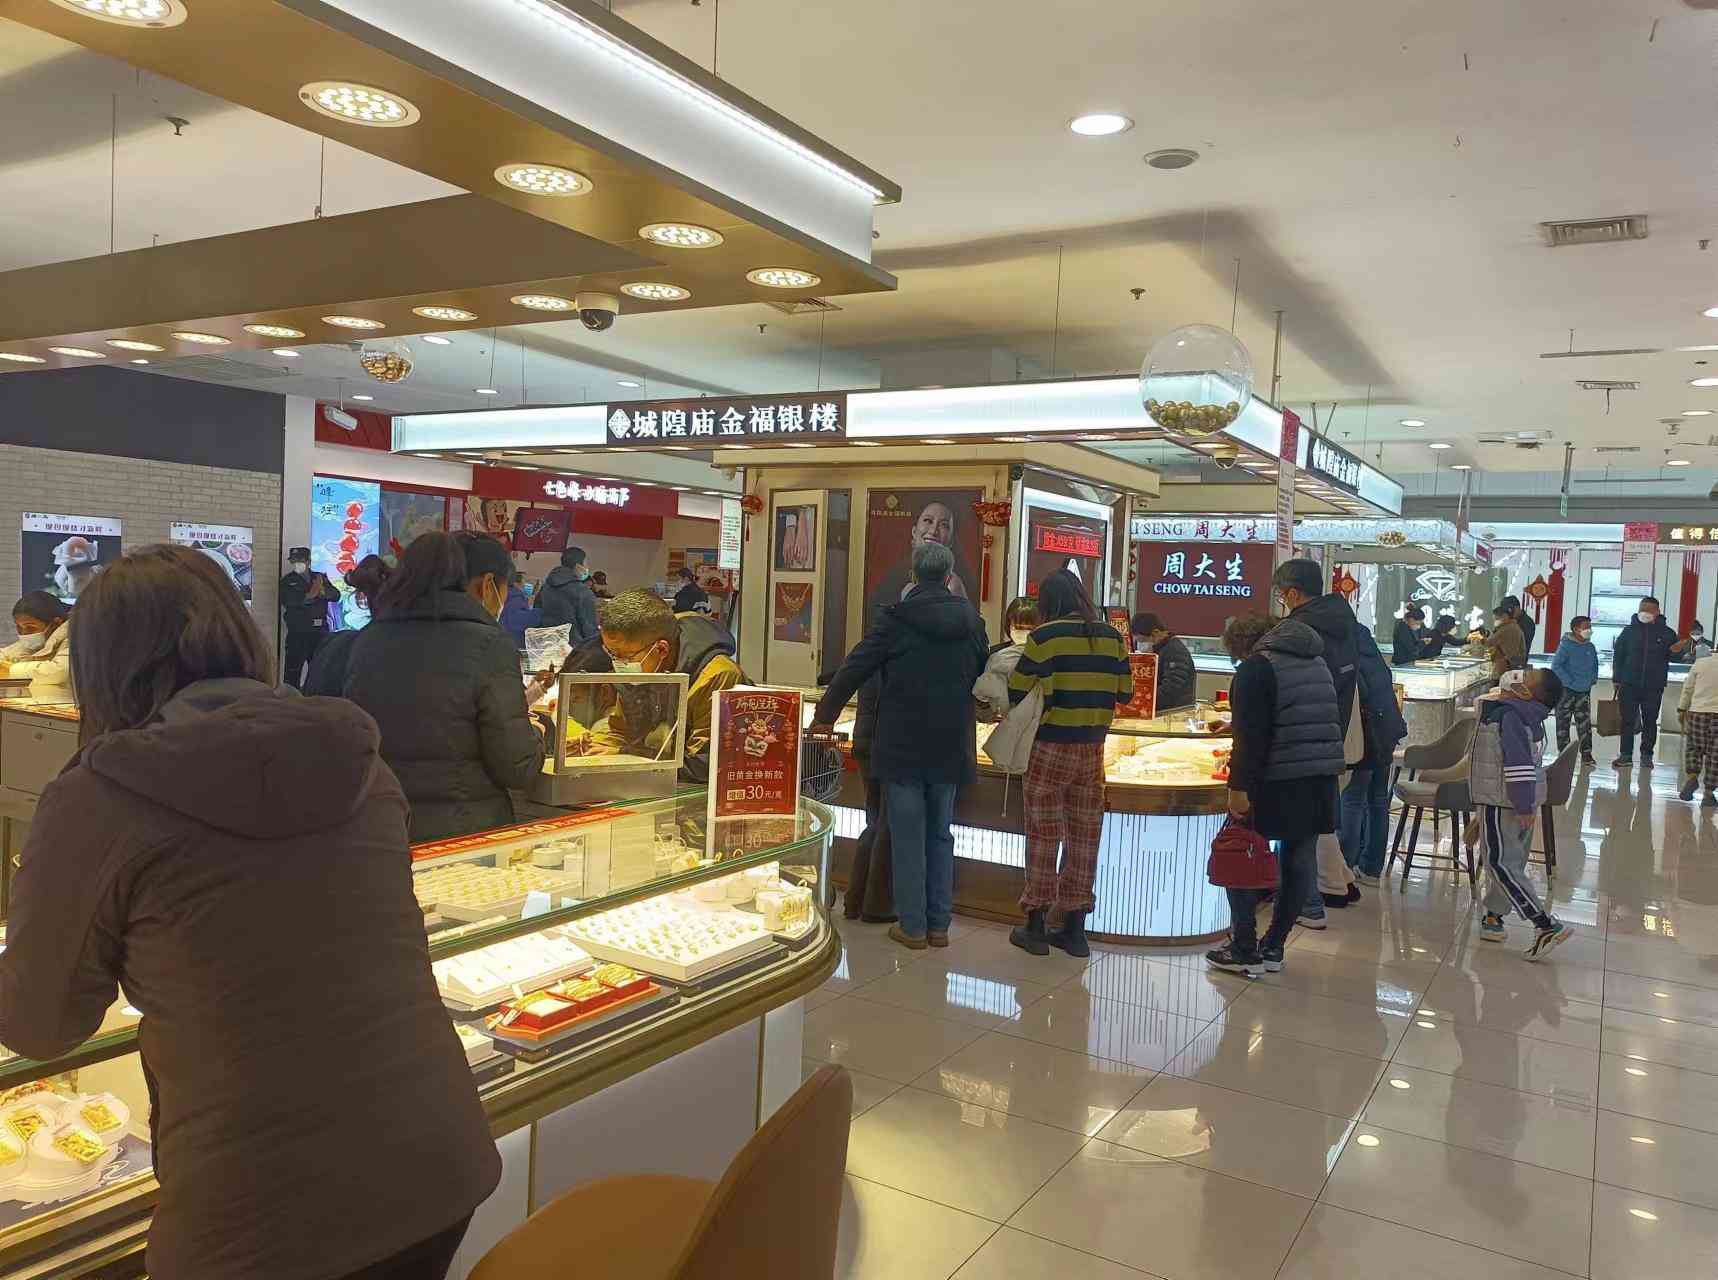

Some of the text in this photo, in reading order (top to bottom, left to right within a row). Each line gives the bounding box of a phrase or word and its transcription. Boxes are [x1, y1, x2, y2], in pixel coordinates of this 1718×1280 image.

[632, 402, 839, 438] 城隍庙金福银楼
[1143, 521, 1183, 536] SENG
[1194, 520, 1258, 540] 周大生
[1162, 551, 1244, 581] 周大生
[1153, 582, 1252, 597] CHOW TAI SENG
